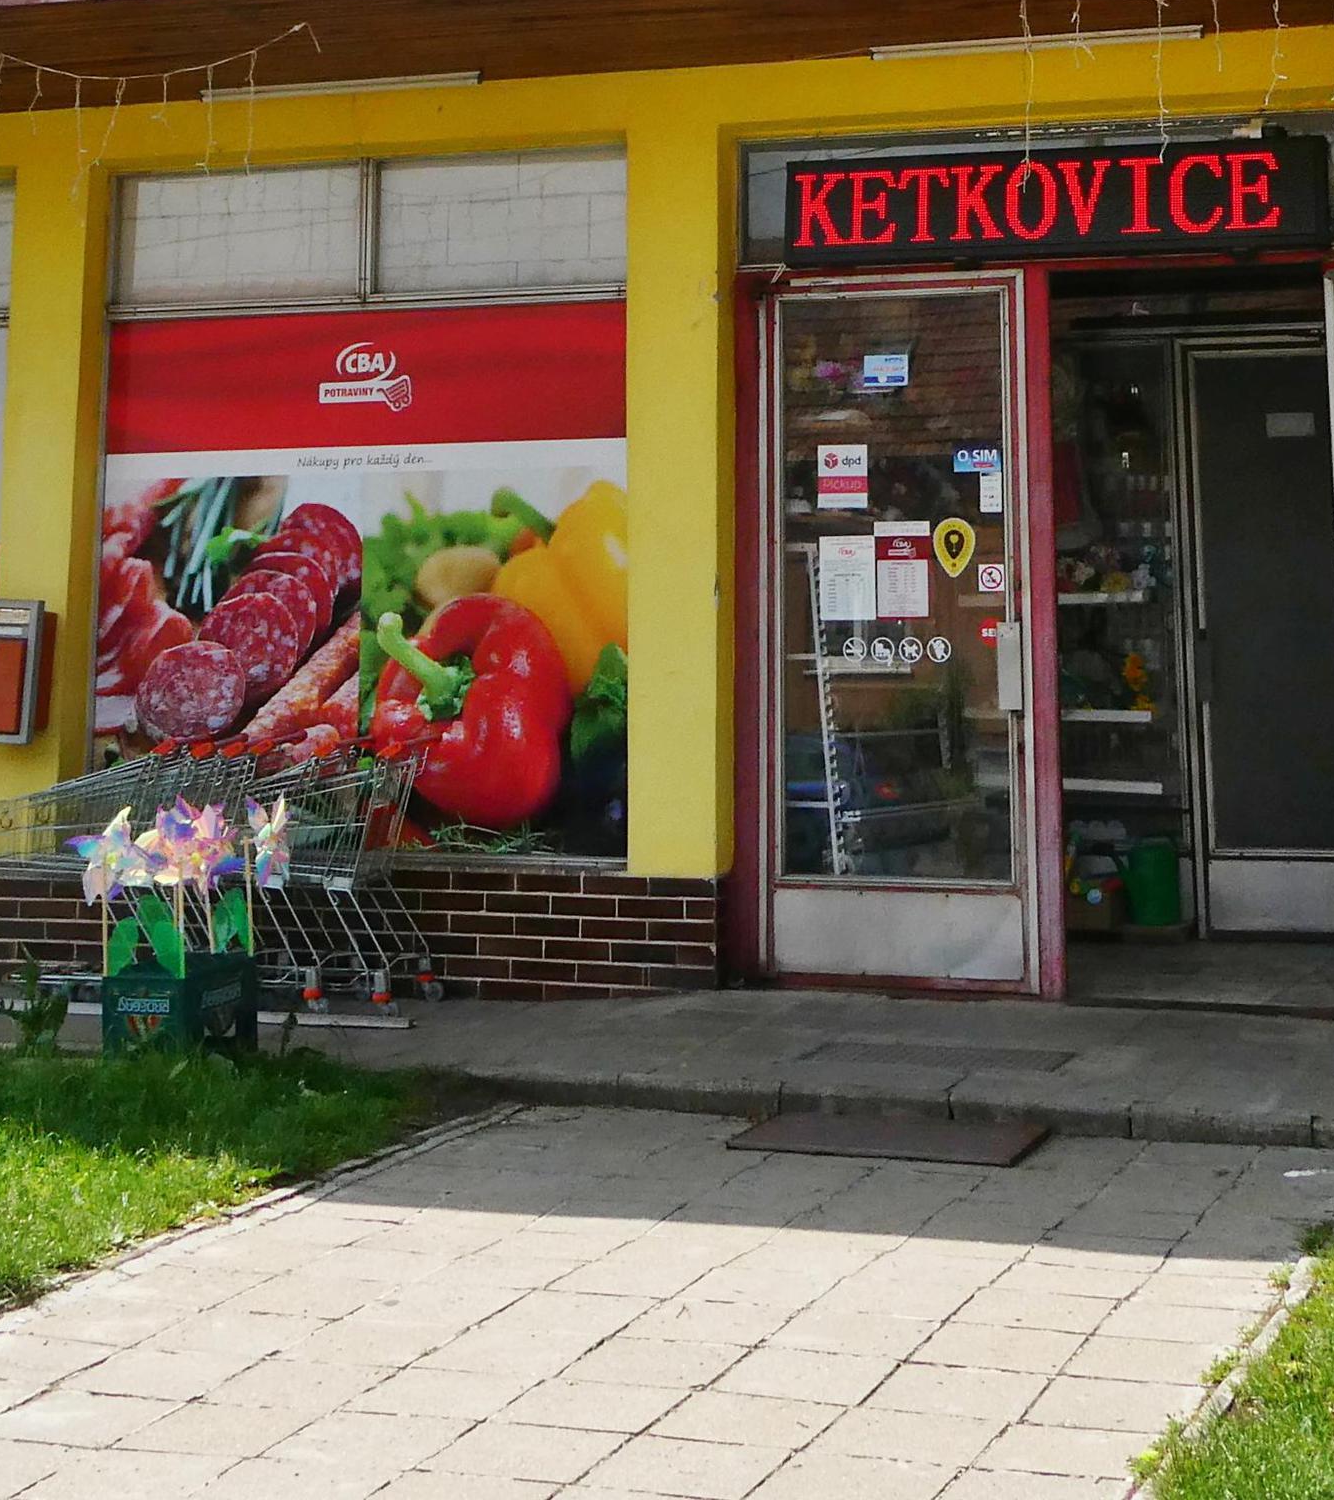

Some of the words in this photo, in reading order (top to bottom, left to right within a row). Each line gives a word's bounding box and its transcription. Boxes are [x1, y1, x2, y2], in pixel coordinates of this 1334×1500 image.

[792, 151, 1282, 248] KETKOVICE
[345, 352, 386, 374] CBA
[323, 386, 375, 398] POTRAVINY
[296, 455, 340, 470] Nákupy
[343, 456, 363, 470] pro
[366, 453, 400, 468] každý
[841, 452, 862, 469] dpd
[972, 448, 998, 463] SIM
